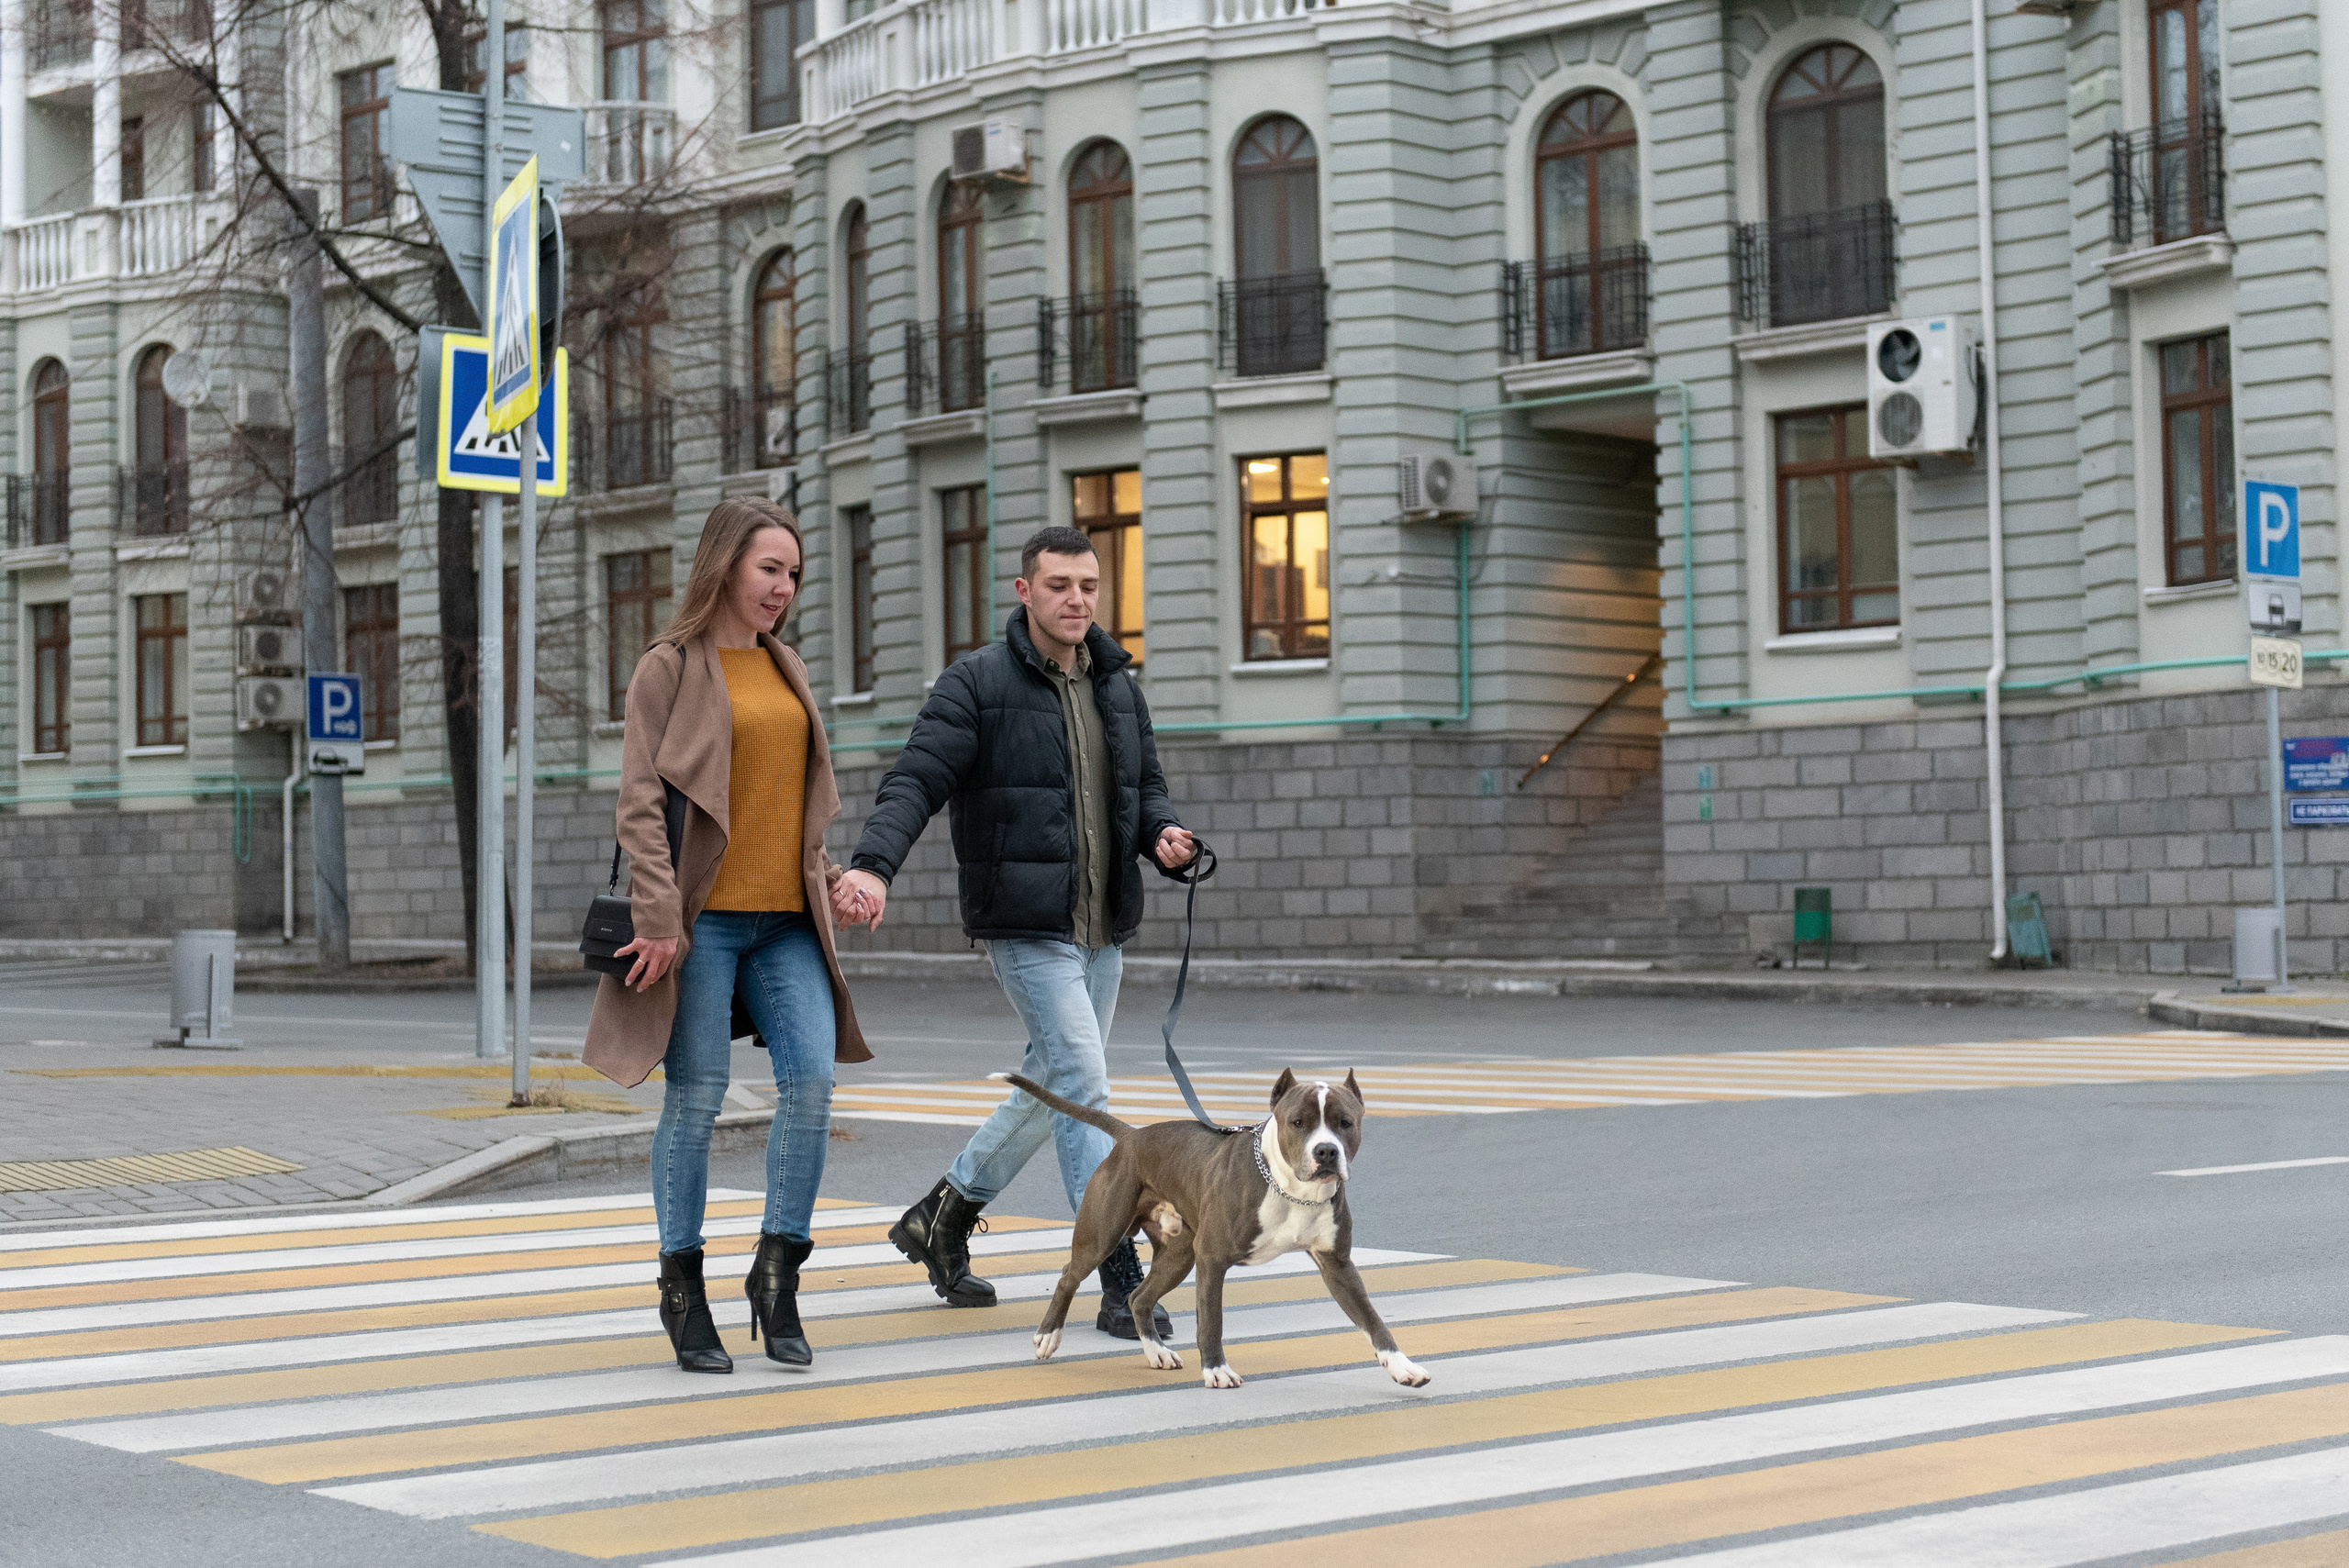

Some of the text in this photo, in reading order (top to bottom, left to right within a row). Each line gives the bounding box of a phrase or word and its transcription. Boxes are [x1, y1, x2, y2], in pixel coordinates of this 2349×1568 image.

[2259, 491, 2290, 568] P
[2268, 652, 2278, 669] 15
[2282, 652, 2298, 673] 20
[322, 680, 353, 735] P
